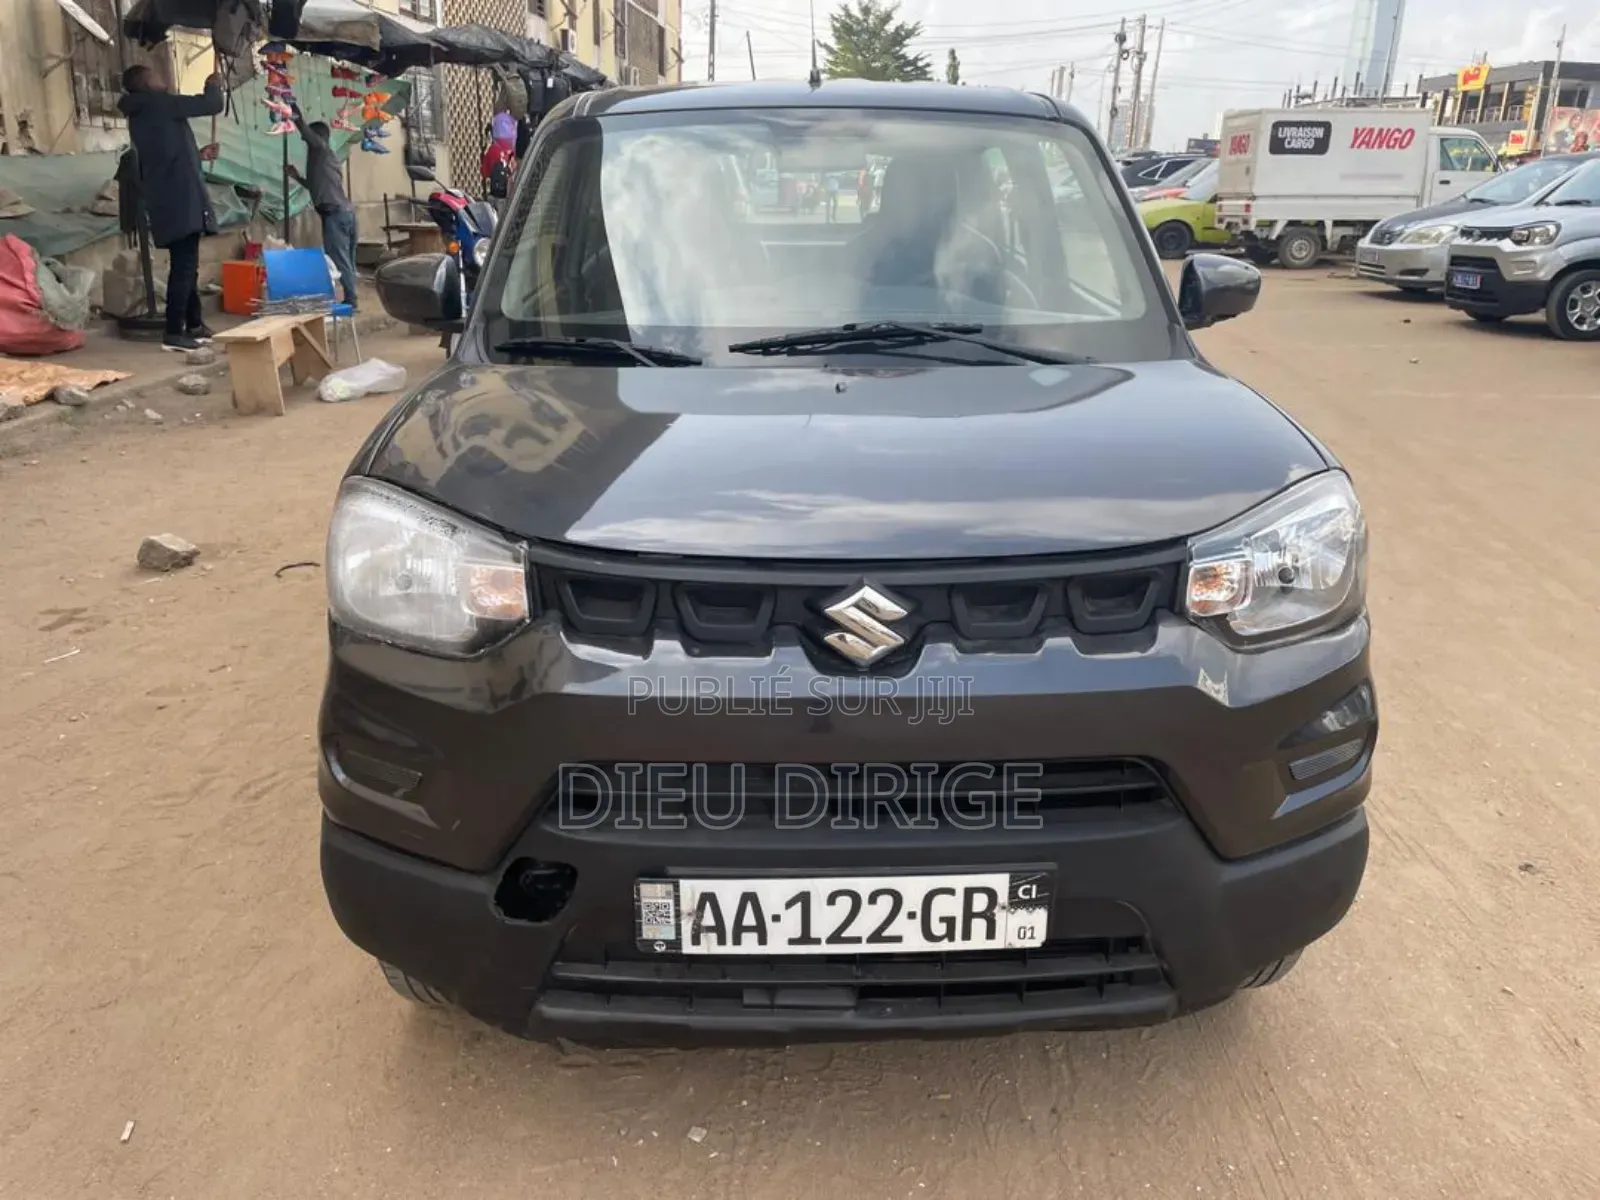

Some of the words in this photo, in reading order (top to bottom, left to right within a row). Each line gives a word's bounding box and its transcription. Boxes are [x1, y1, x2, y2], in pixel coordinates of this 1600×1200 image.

[1277, 126, 1325, 139] LIVRAISON
[1350, 127, 1416, 150] YANGO
[1283, 138, 1315, 149] CARGO
[1017, 884, 1037, 899] CI
[1017, 925, 1037, 940] 01
